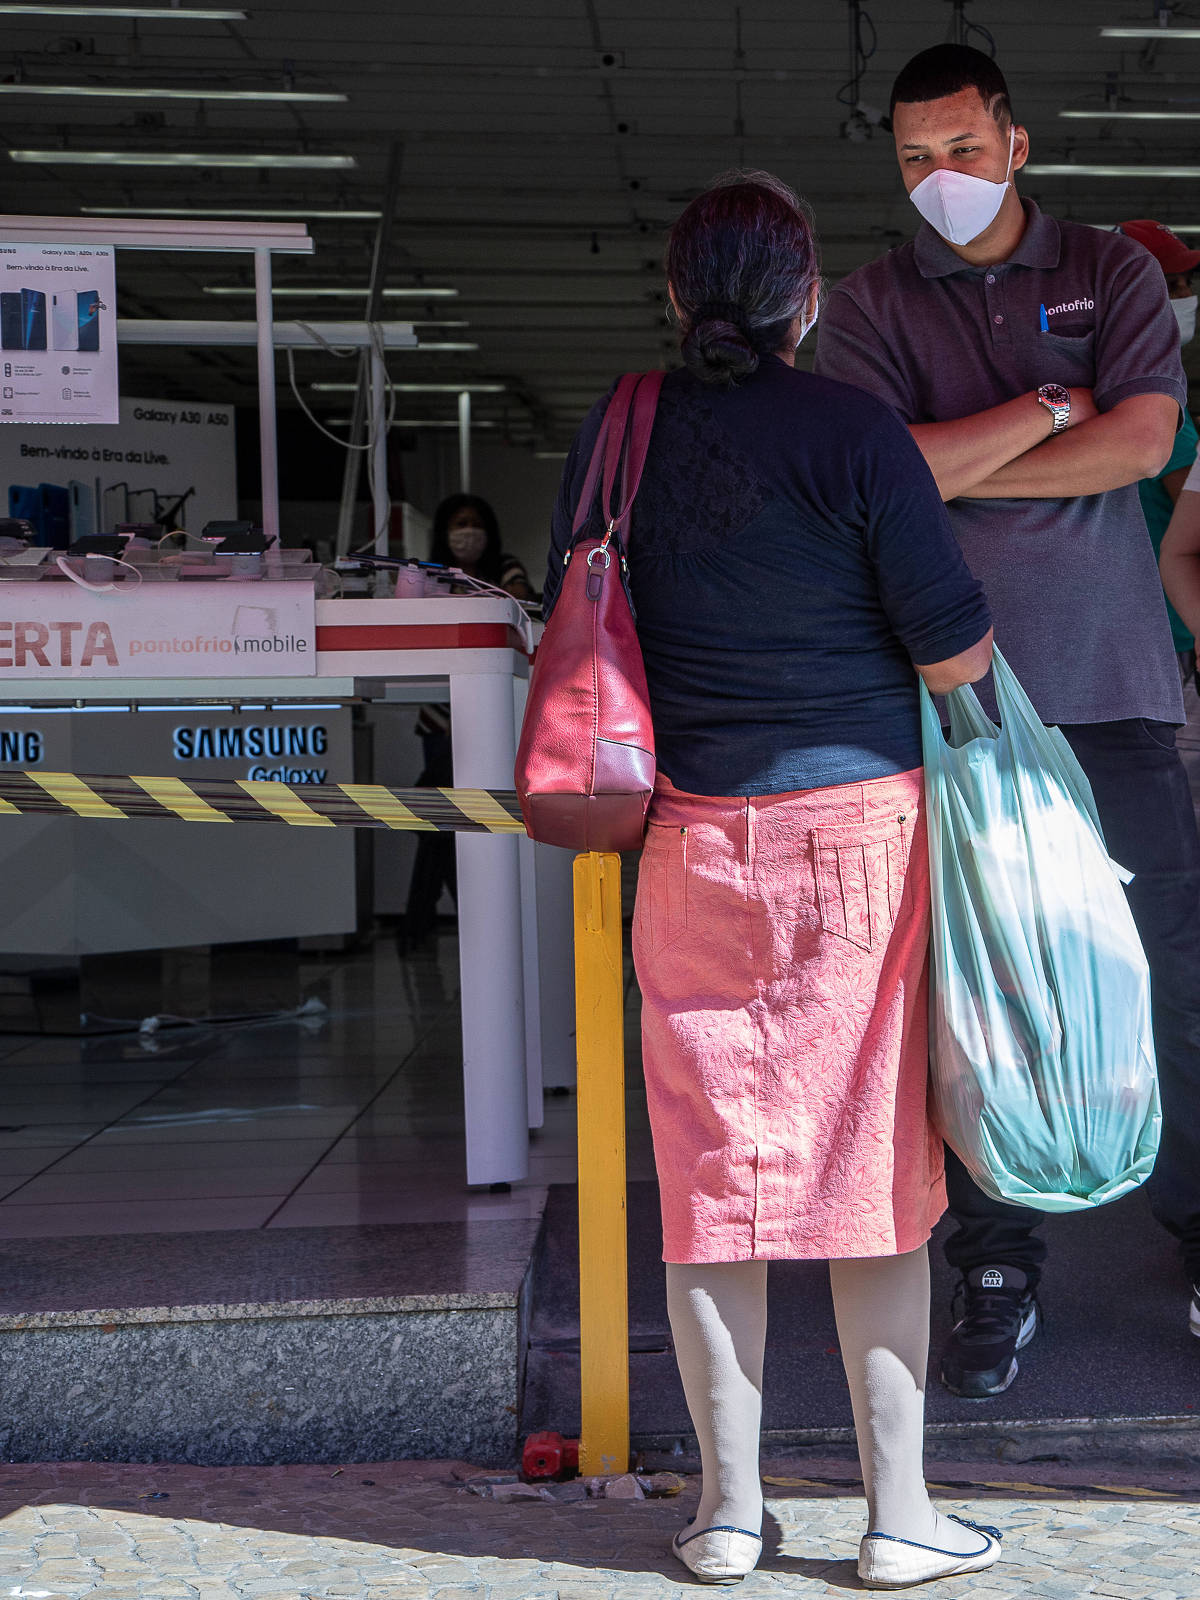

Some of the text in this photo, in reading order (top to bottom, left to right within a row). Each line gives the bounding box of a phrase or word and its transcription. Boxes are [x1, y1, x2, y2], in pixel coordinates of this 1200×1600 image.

[1045, 298, 1094, 316] ontofrio
[133, 408, 229, 426] Galaxy A30 A50
[20, 444, 89, 461] Bem-vindo
[103, 449, 123, 462] Era
[125, 450, 142, 463] da
[144, 450, 170, 465] Live.
[129, 635, 307, 656] pontofrio mobile
[175, 726, 327, 759] SAMSUNG
